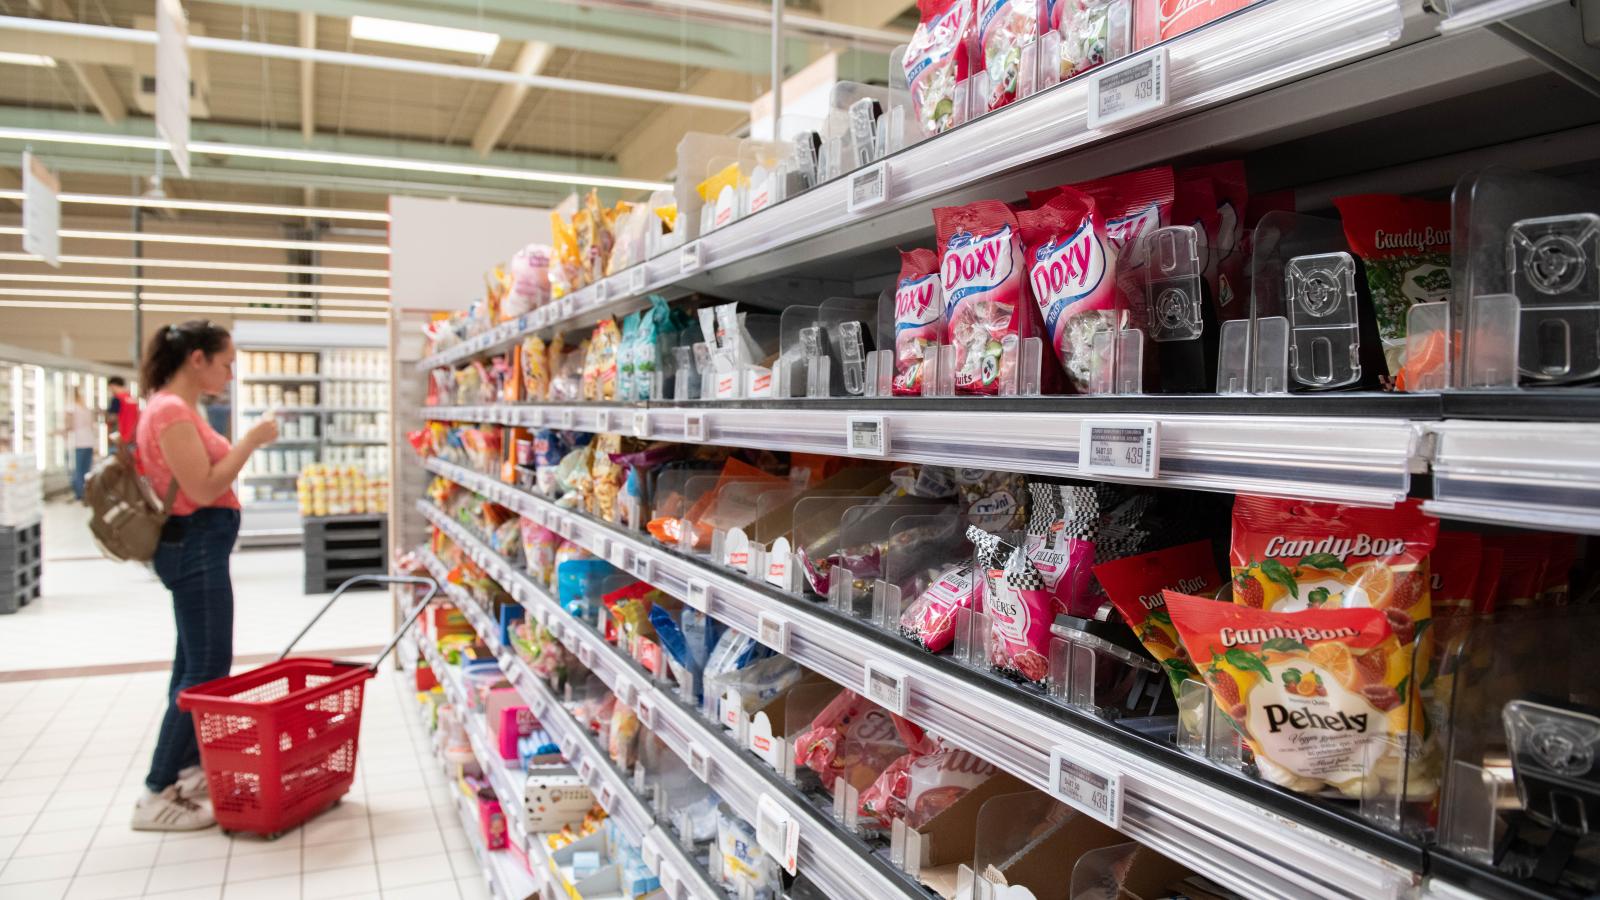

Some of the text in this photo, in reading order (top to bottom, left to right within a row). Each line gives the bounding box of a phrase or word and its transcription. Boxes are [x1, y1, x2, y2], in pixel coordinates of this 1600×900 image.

[1134, 79, 1152, 100] 439
[1125, 446, 1144, 465] 439
[1264, 533, 1406, 562] CandyBon
[1219, 625, 1360, 649] CandyBon
[1262, 703, 1369, 734] Pehely
[1091, 790, 1108, 812] 439
